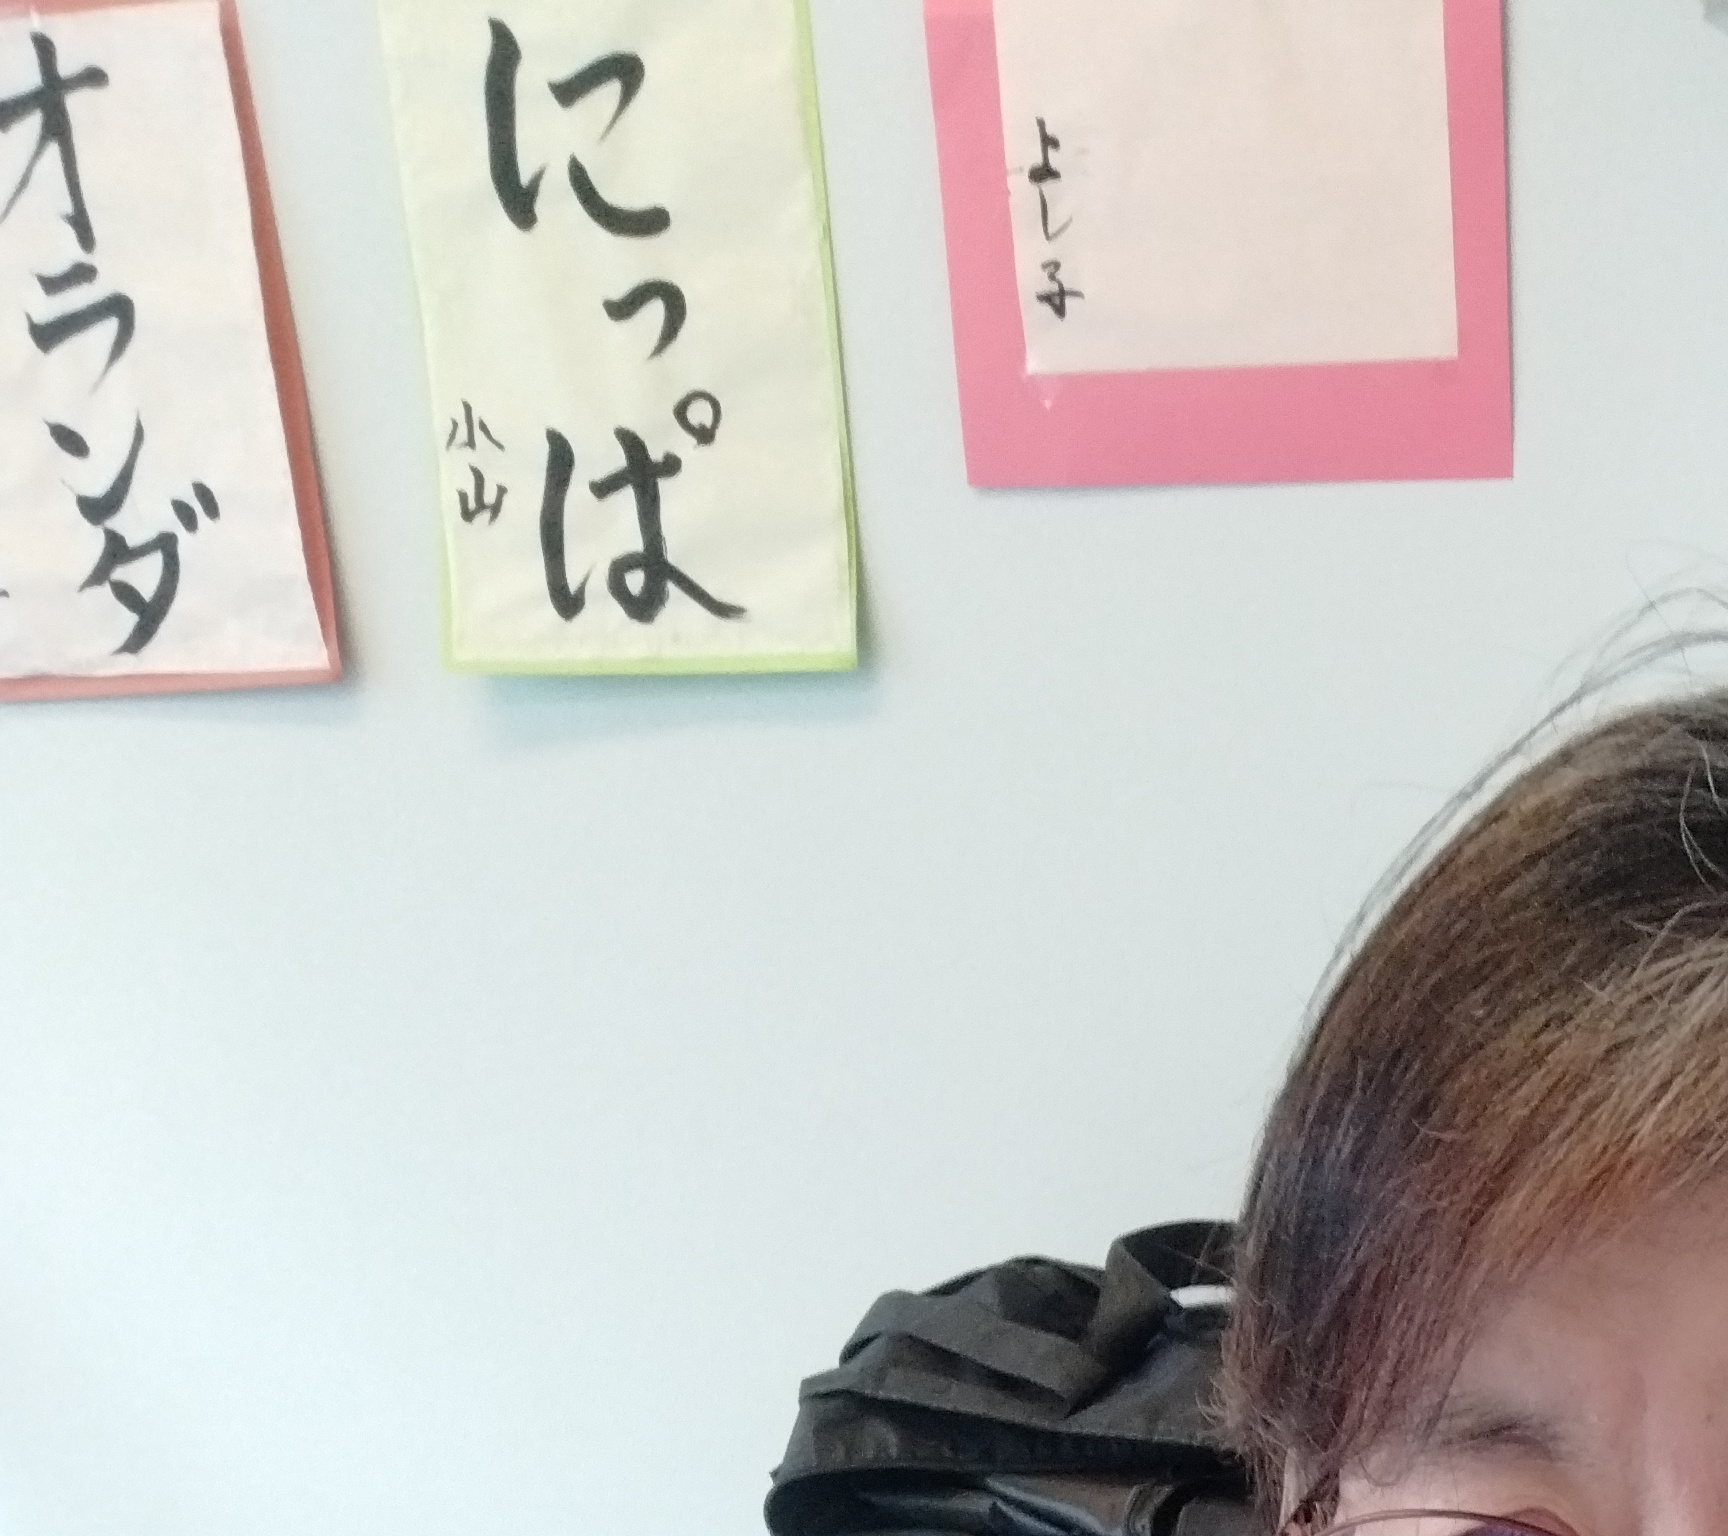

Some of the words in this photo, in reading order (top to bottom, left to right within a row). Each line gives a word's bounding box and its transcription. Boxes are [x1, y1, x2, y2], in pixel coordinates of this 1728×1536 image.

[0, 30, 221, 655] オランダ
[445, 400, 508, 525] 小山
[484, 18, 747, 625] にっぱ
